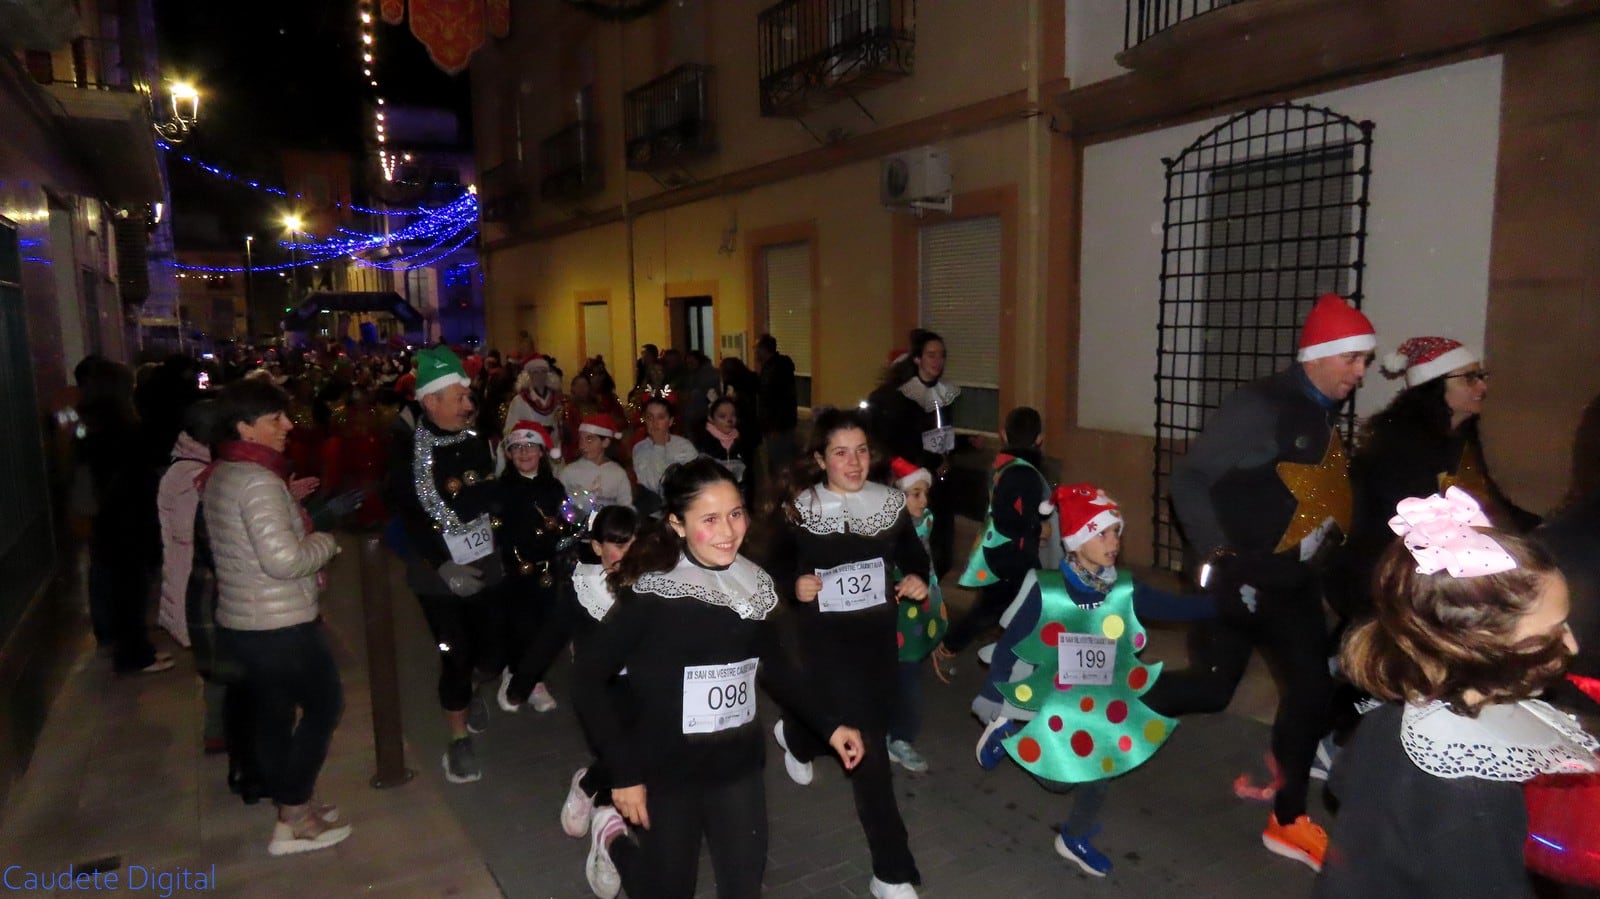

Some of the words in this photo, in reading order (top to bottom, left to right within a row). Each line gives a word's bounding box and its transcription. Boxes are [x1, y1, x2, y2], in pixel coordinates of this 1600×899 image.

[463, 528, 490, 550] 128
[836, 574, 872, 596] 132
[1076, 649, 1106, 669] 199
[694, 670, 707, 680] SAN
[708, 666, 737, 679] SILVESTRE
[708, 681, 747, 710] 098
